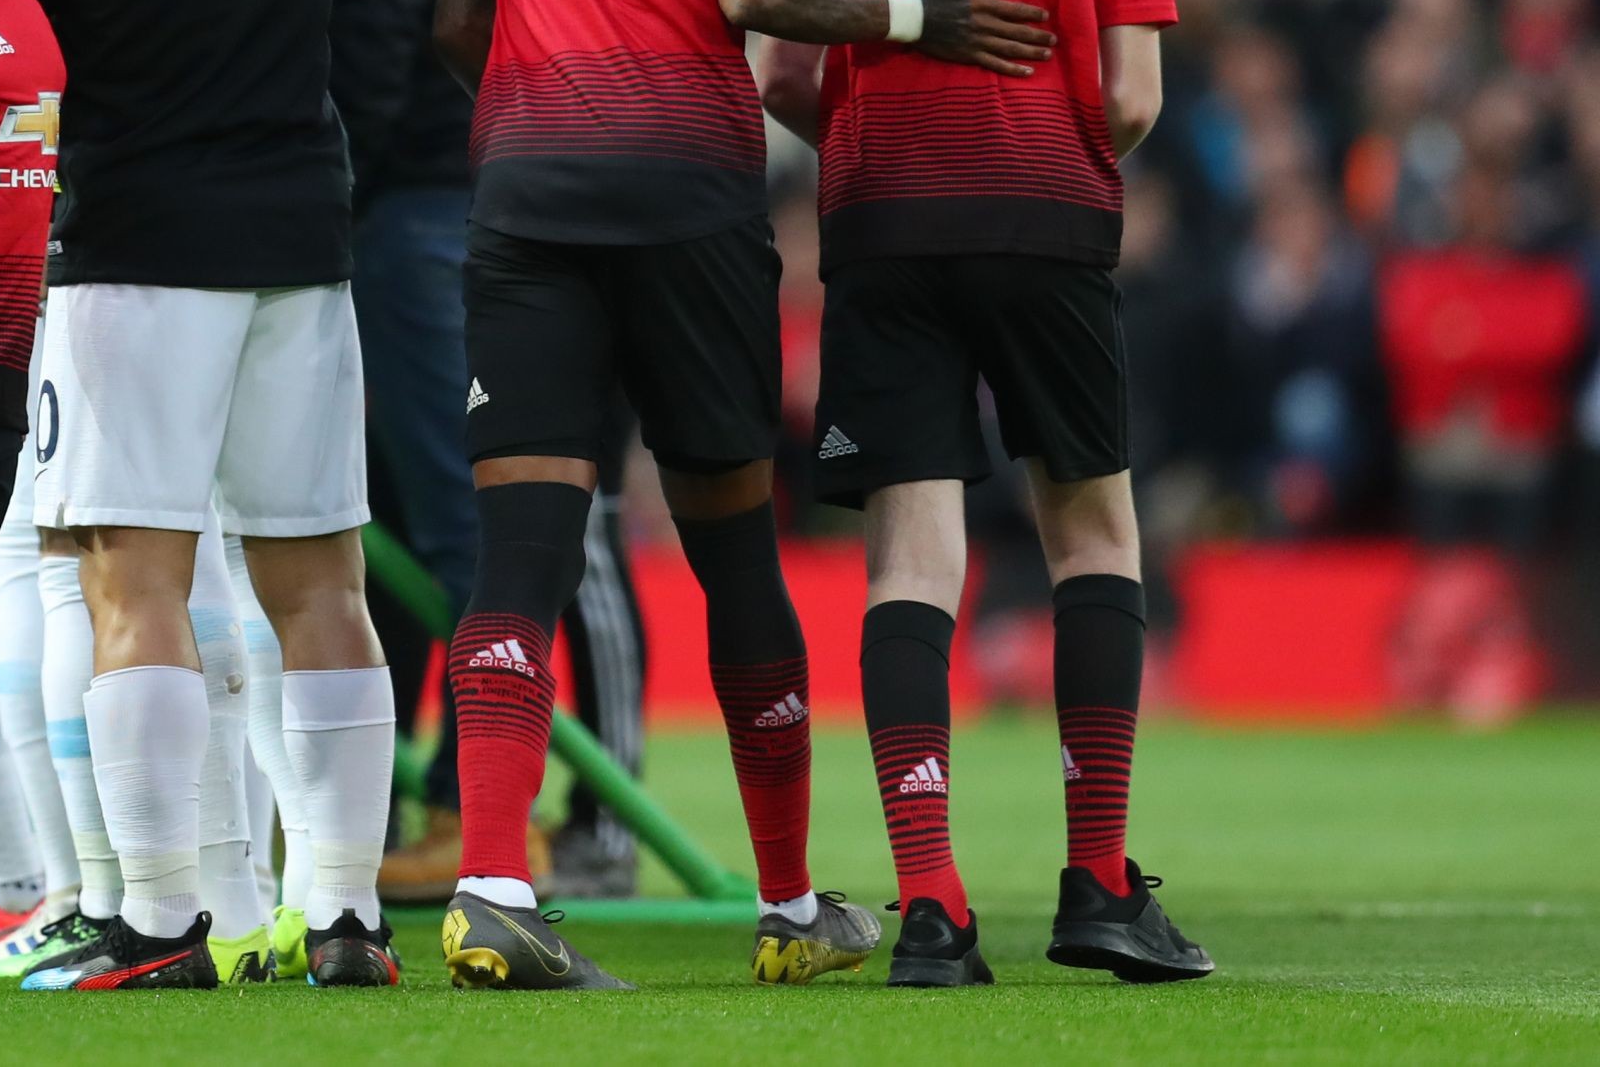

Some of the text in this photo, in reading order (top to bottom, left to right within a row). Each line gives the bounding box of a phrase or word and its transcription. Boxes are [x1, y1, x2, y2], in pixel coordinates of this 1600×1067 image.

[818, 443, 859, 460] adidas
[468, 653, 536, 678] adidas
[754, 706, 809, 727] adidas
[900, 779, 947, 794] adidas
